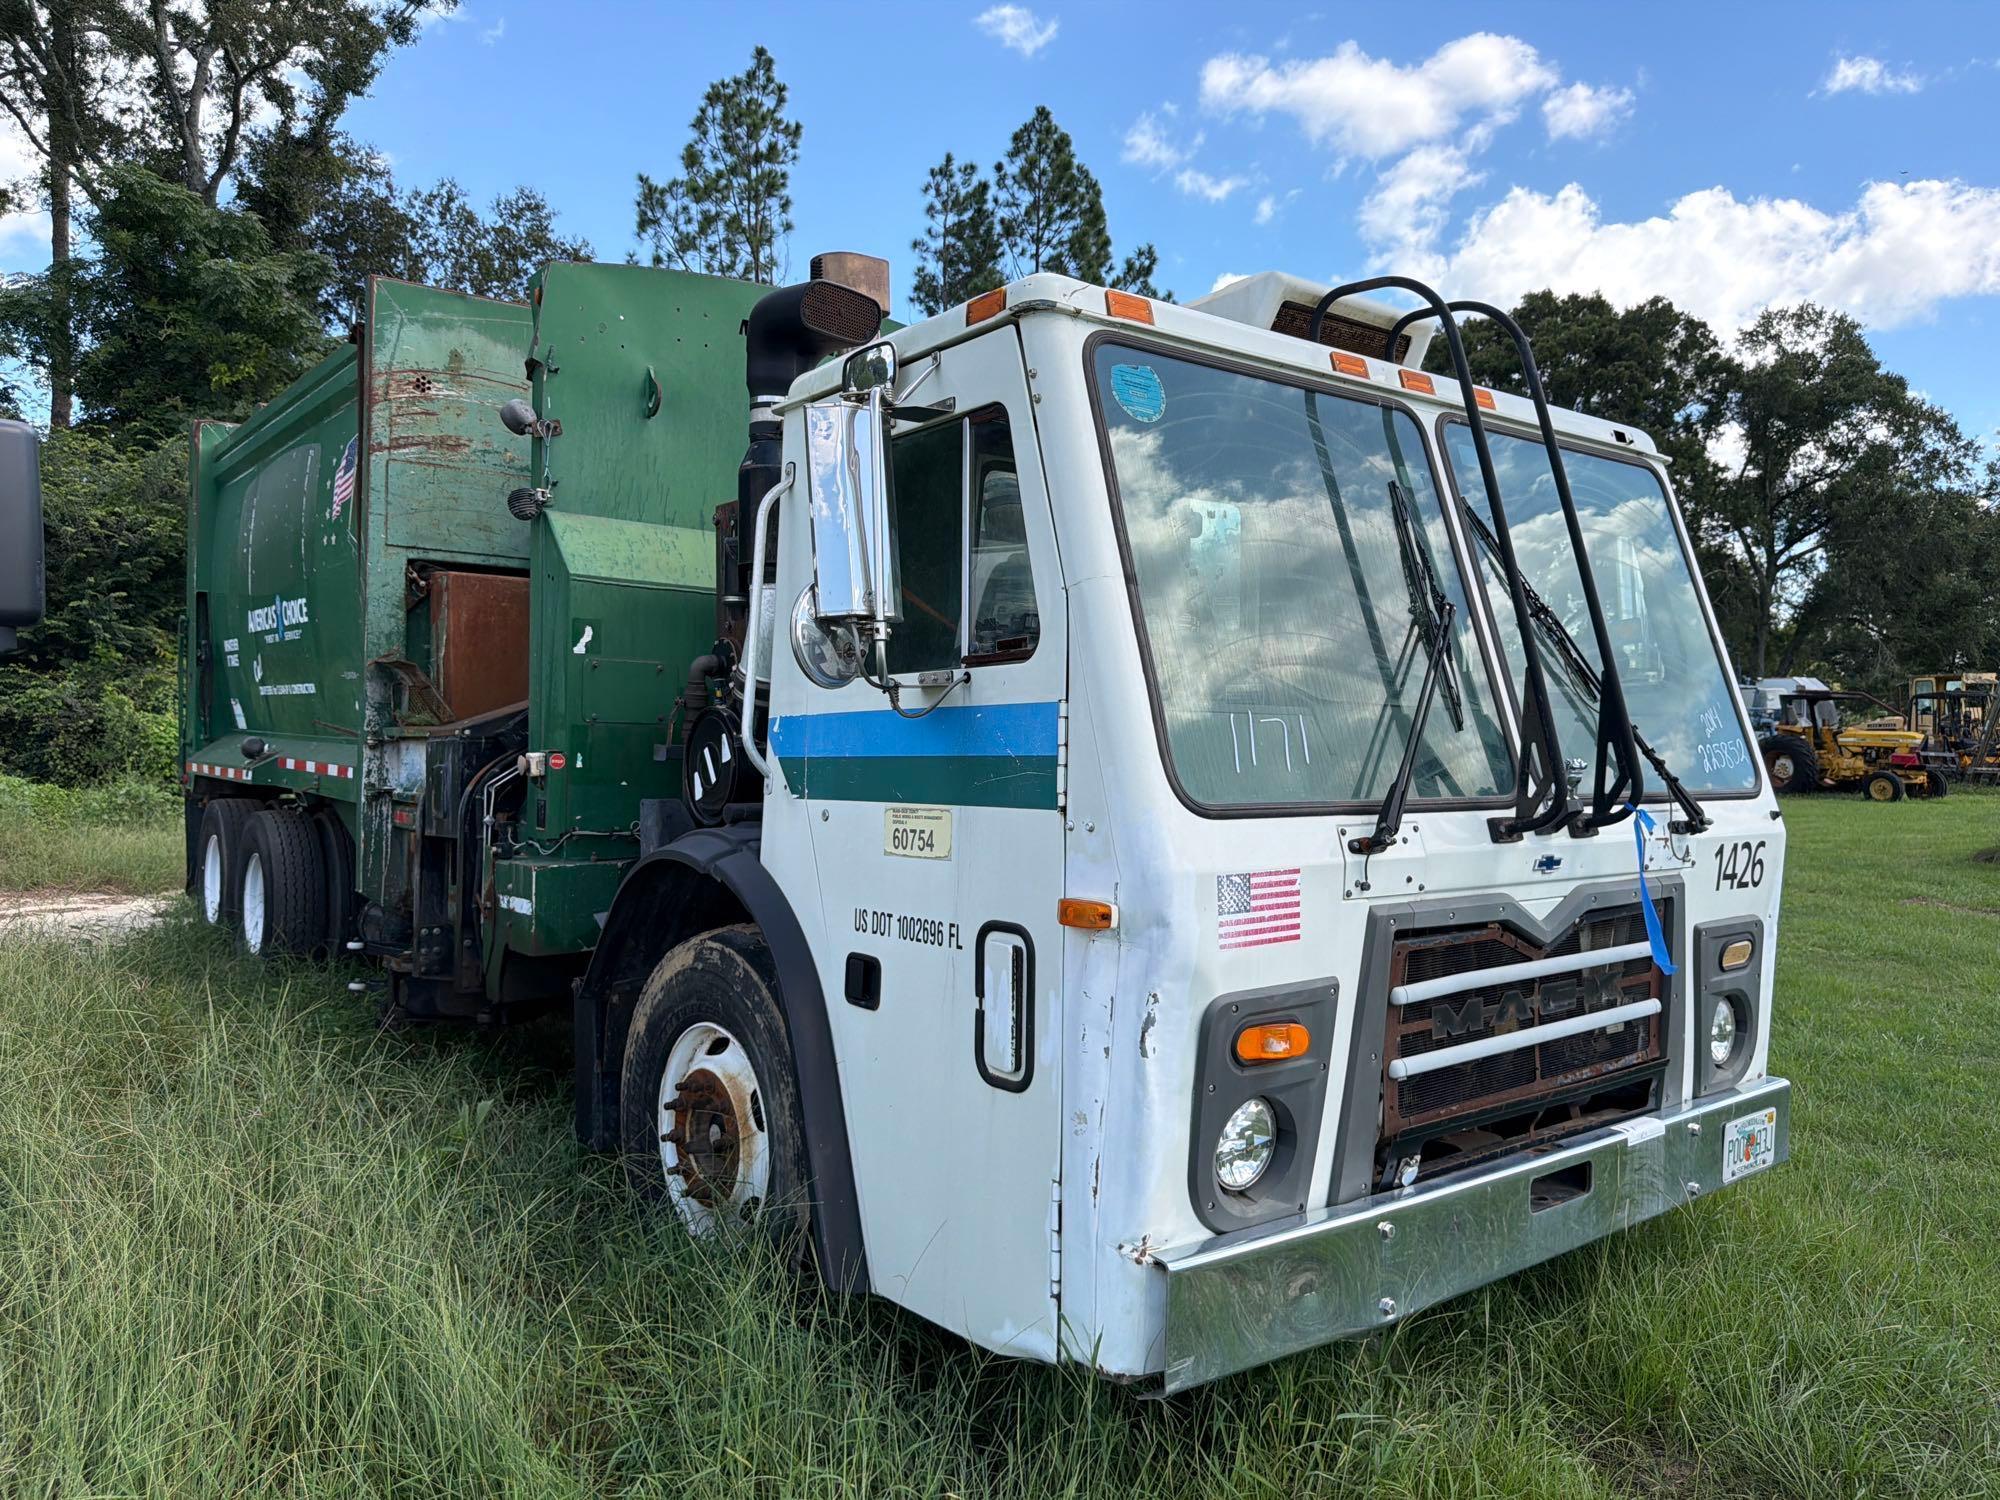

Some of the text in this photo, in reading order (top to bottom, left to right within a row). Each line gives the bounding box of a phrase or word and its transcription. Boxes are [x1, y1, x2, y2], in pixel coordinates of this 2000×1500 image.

[282, 597, 309, 626] CHOICE
[1230, 708, 1310, 774] 1171
[1698, 738, 1750, 773] 225852
[892, 827, 935, 852] 60754
[1714, 840, 1766, 892] 1426
[854, 907, 963, 950] US DOT 1002696 FL
[1431, 970, 1625, 1040] MACK
